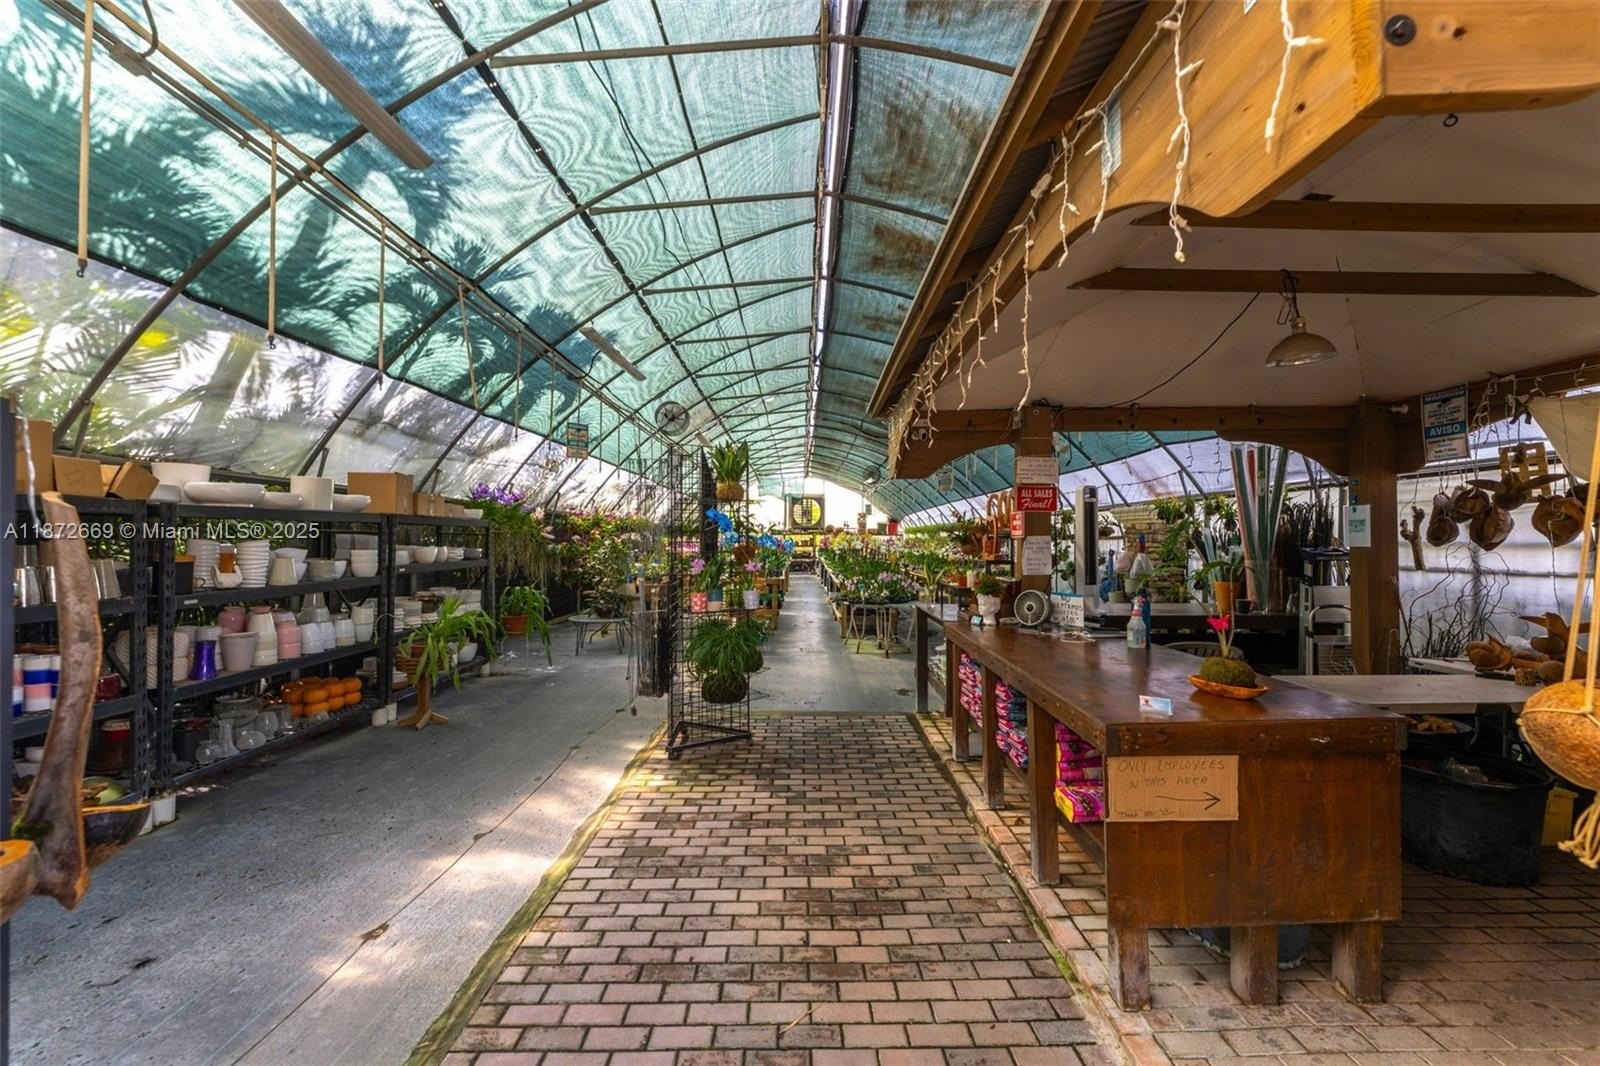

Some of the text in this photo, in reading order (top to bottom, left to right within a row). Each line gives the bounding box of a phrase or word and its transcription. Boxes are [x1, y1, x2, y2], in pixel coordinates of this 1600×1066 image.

[1430, 424, 1460, 437] AVISO
[1021, 489, 1053, 498] ALL SALES
[1021, 498, 1053, 510] Final!
[1118, 759, 1225, 773] ONLY EMPLOYEES
[1128, 776, 1209, 789] IN THIS AREA
